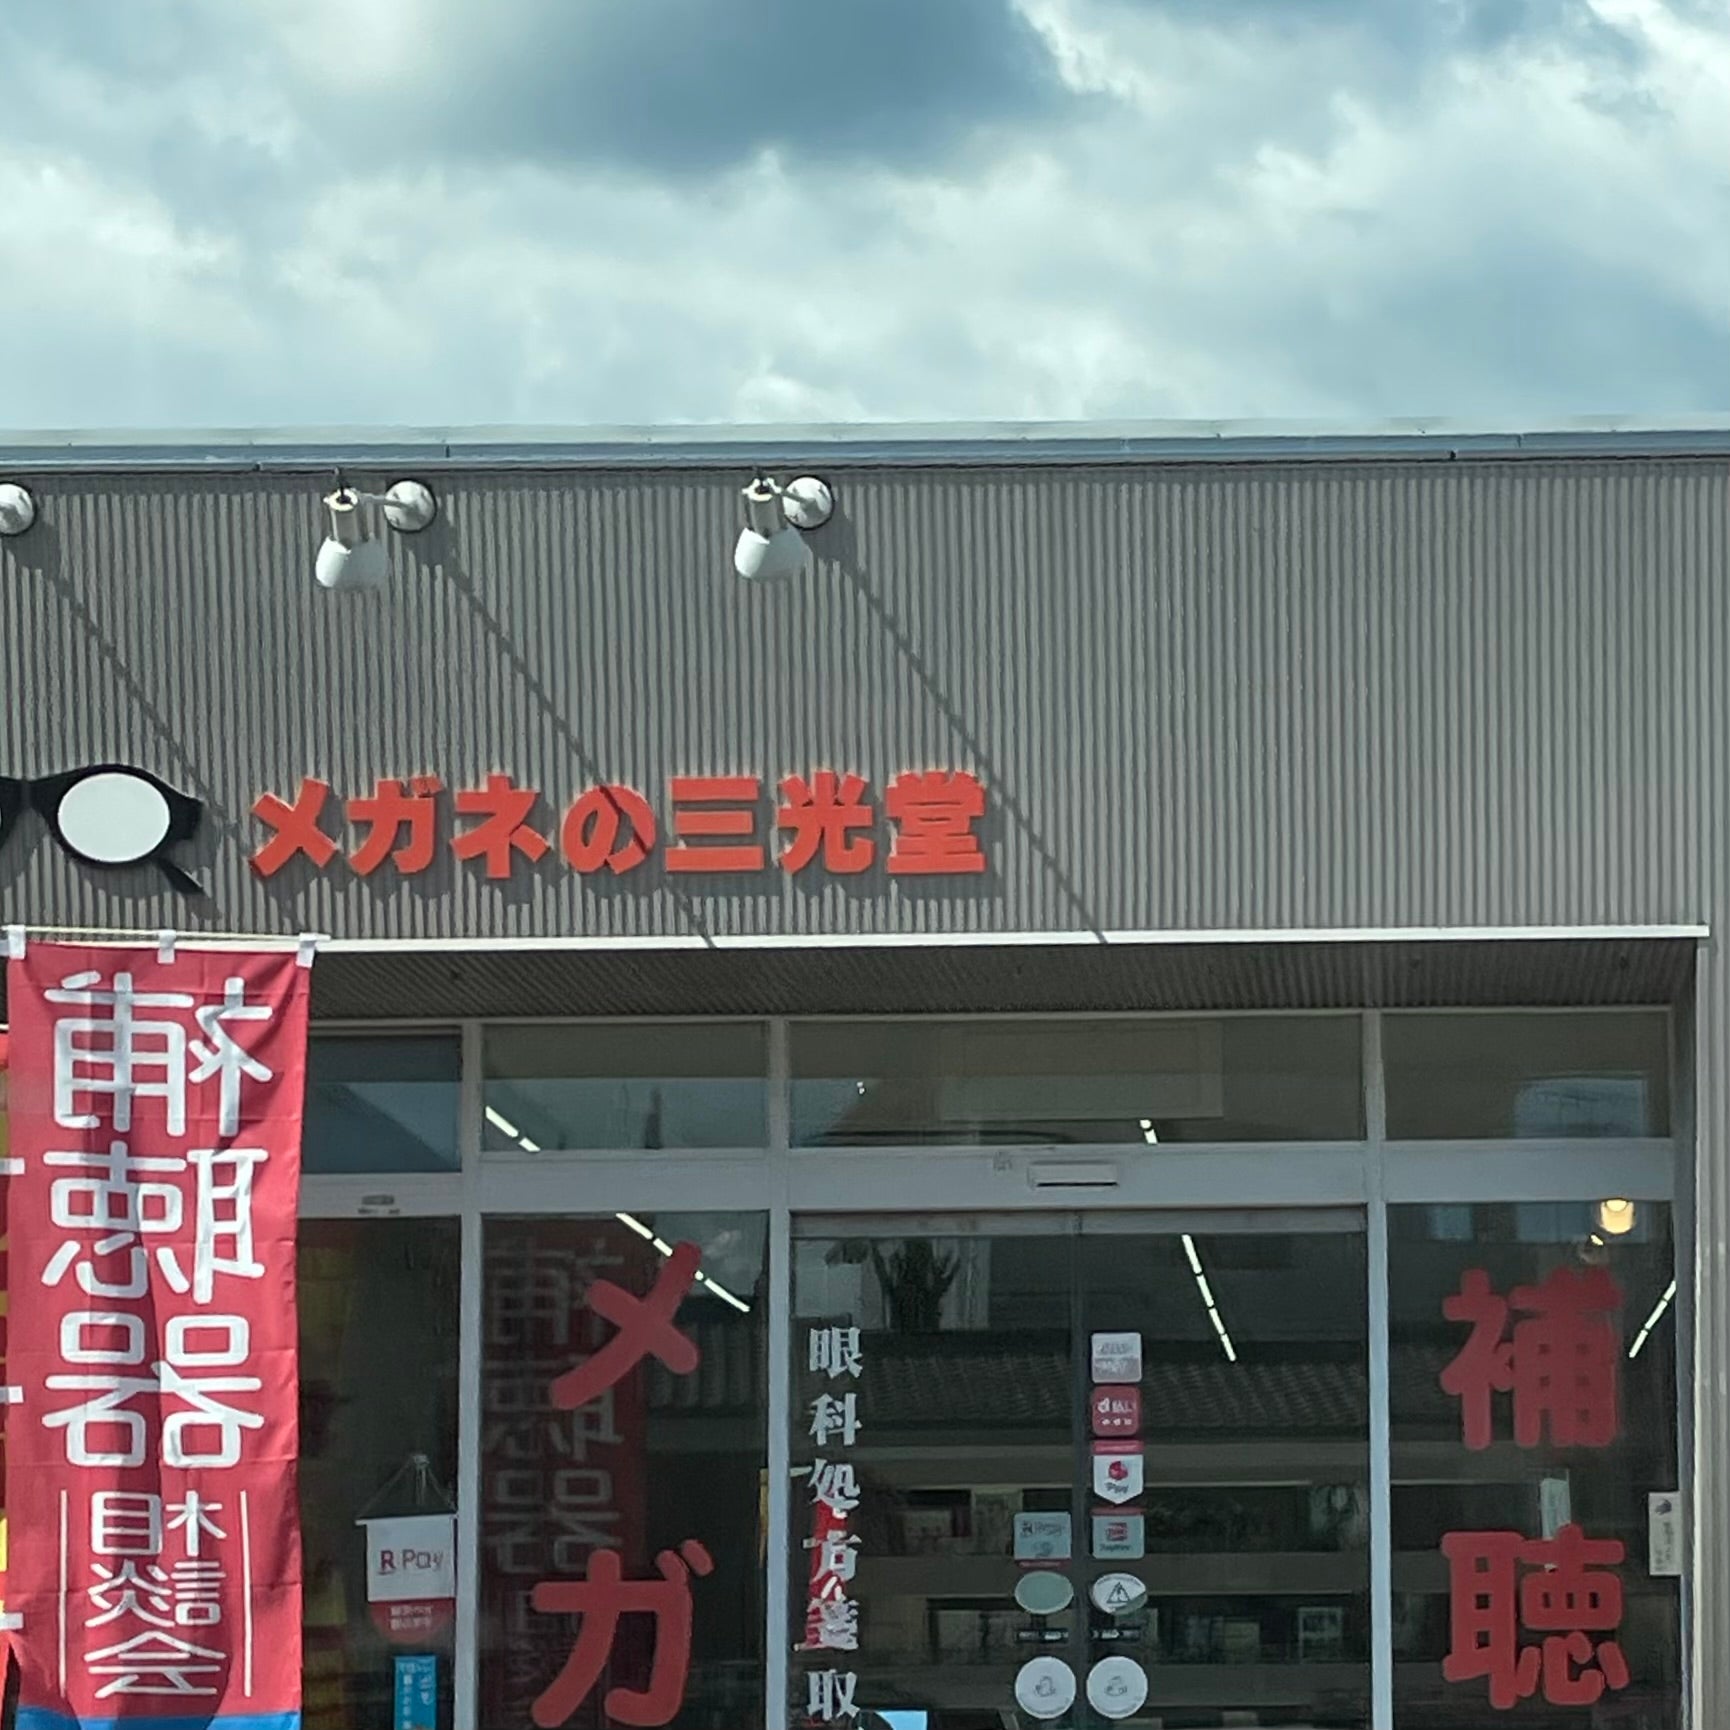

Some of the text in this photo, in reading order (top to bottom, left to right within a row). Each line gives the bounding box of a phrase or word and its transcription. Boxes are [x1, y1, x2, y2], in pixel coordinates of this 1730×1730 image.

[247, 770, 987, 878] メガネの三光堂
[402, 1548, 445, 1571] Pay
[530, 1240, 715, 1729] メガ
[1440, 1266, 1630, 1709] 補聴
